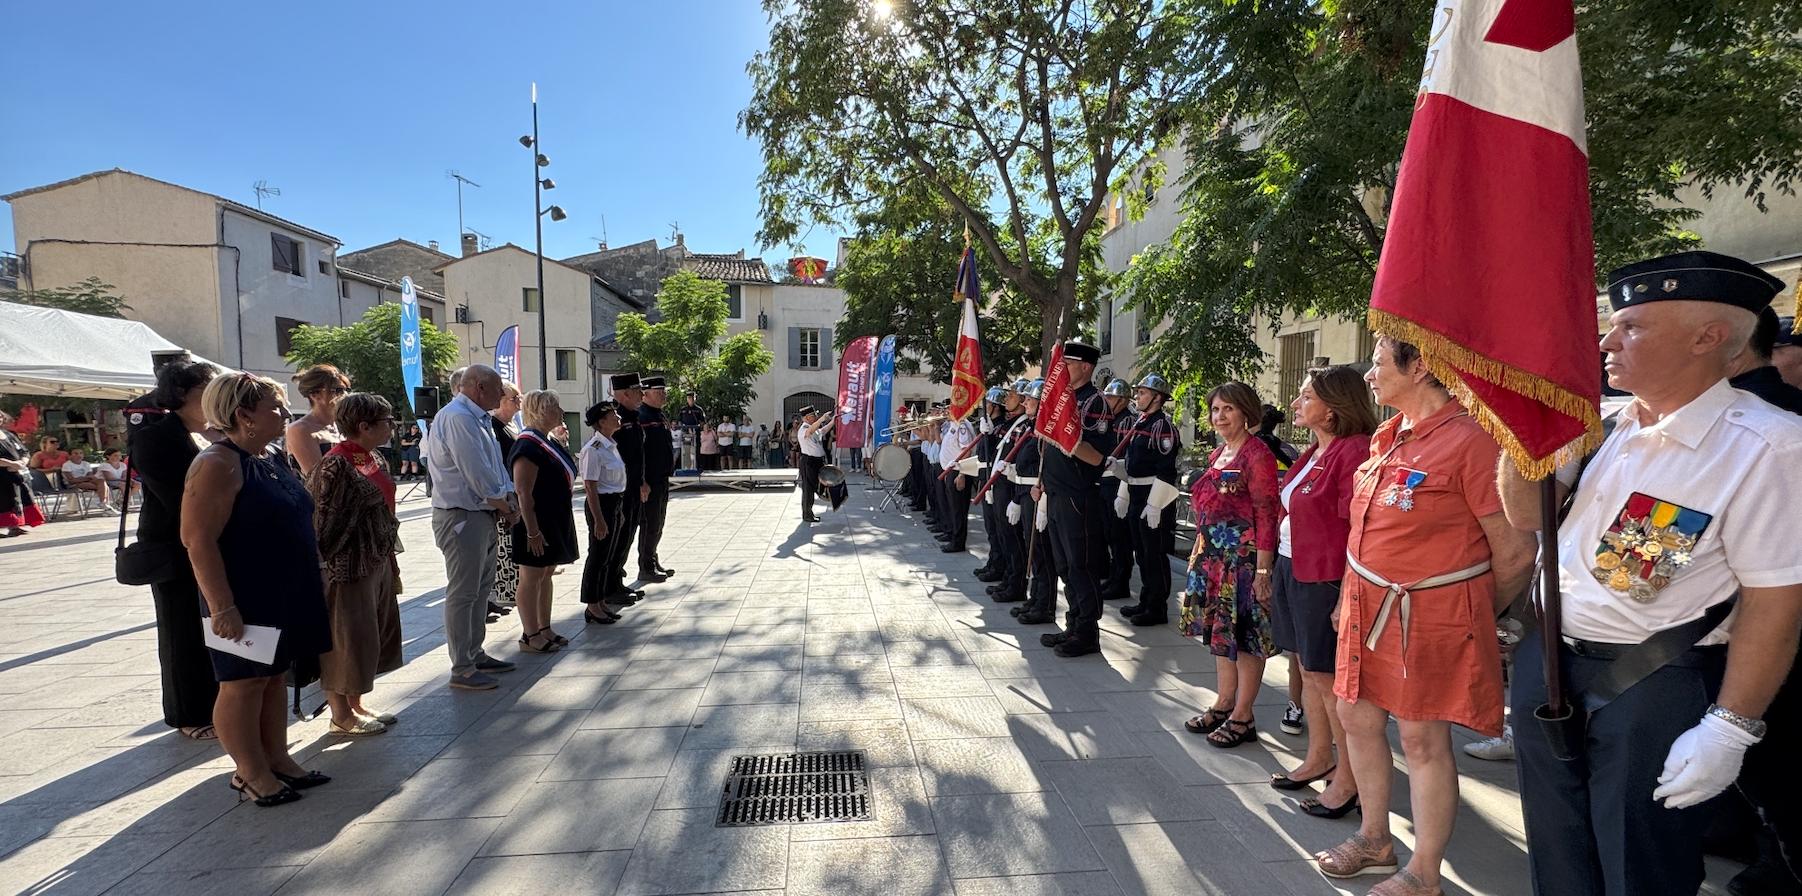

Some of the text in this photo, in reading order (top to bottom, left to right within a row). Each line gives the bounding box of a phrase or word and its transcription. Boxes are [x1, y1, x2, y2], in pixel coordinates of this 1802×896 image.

[1044, 421, 1056, 434] DES
[1051, 391, 1070, 421] SAPEURS
[1064, 422, 1076, 435] DE
